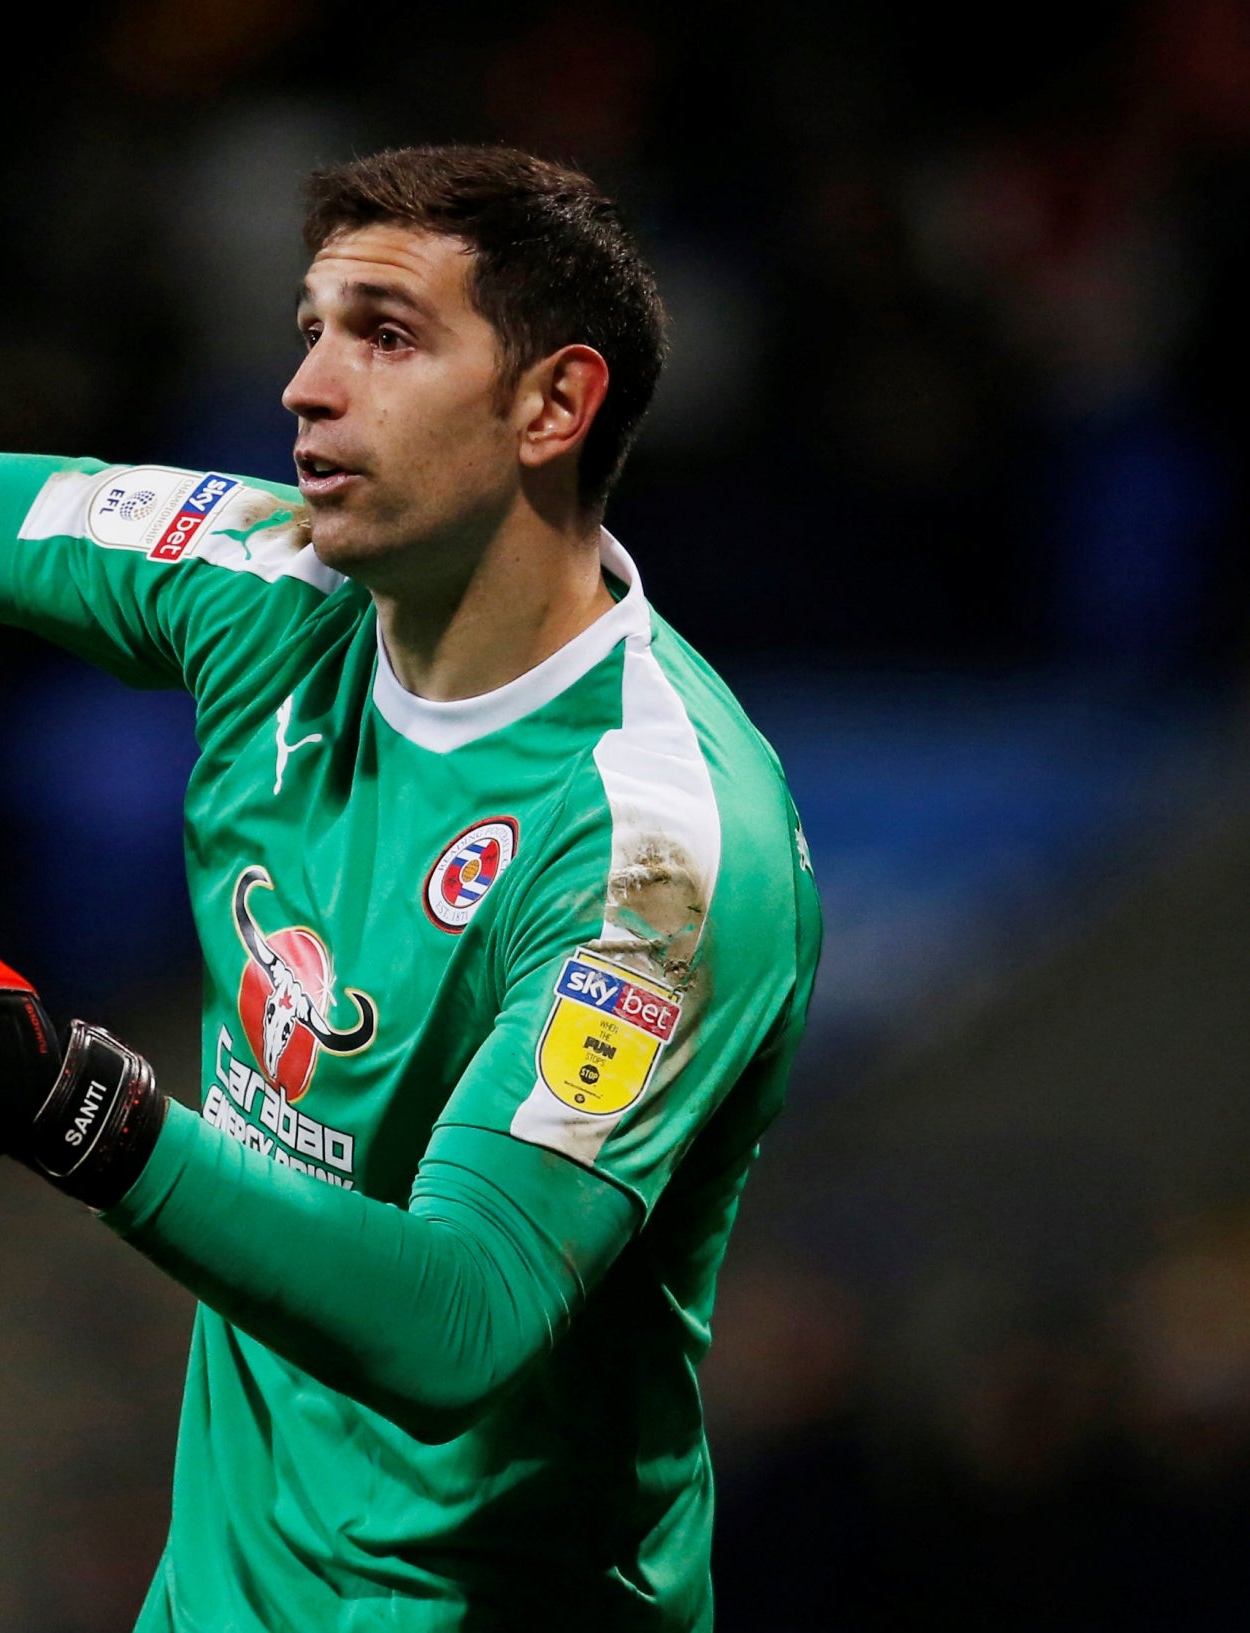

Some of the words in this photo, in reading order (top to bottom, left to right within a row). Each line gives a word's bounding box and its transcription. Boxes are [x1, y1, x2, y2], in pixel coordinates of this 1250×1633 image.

[99, 488, 126, 515] EFL
[145, 479, 195, 544] CHAMPIONSHIP
[188, 479, 228, 512] sky
[159, 516, 203, 556] bet
[566, 970, 618, 1006] sky
[622, 987, 672, 1030] bet
[582, 1036, 617, 1060] FUN
[599, 1030, 613, 1041] THE
[580, 1067, 599, 1081] STOP
[65, 1080, 107, 1146] SANTI
